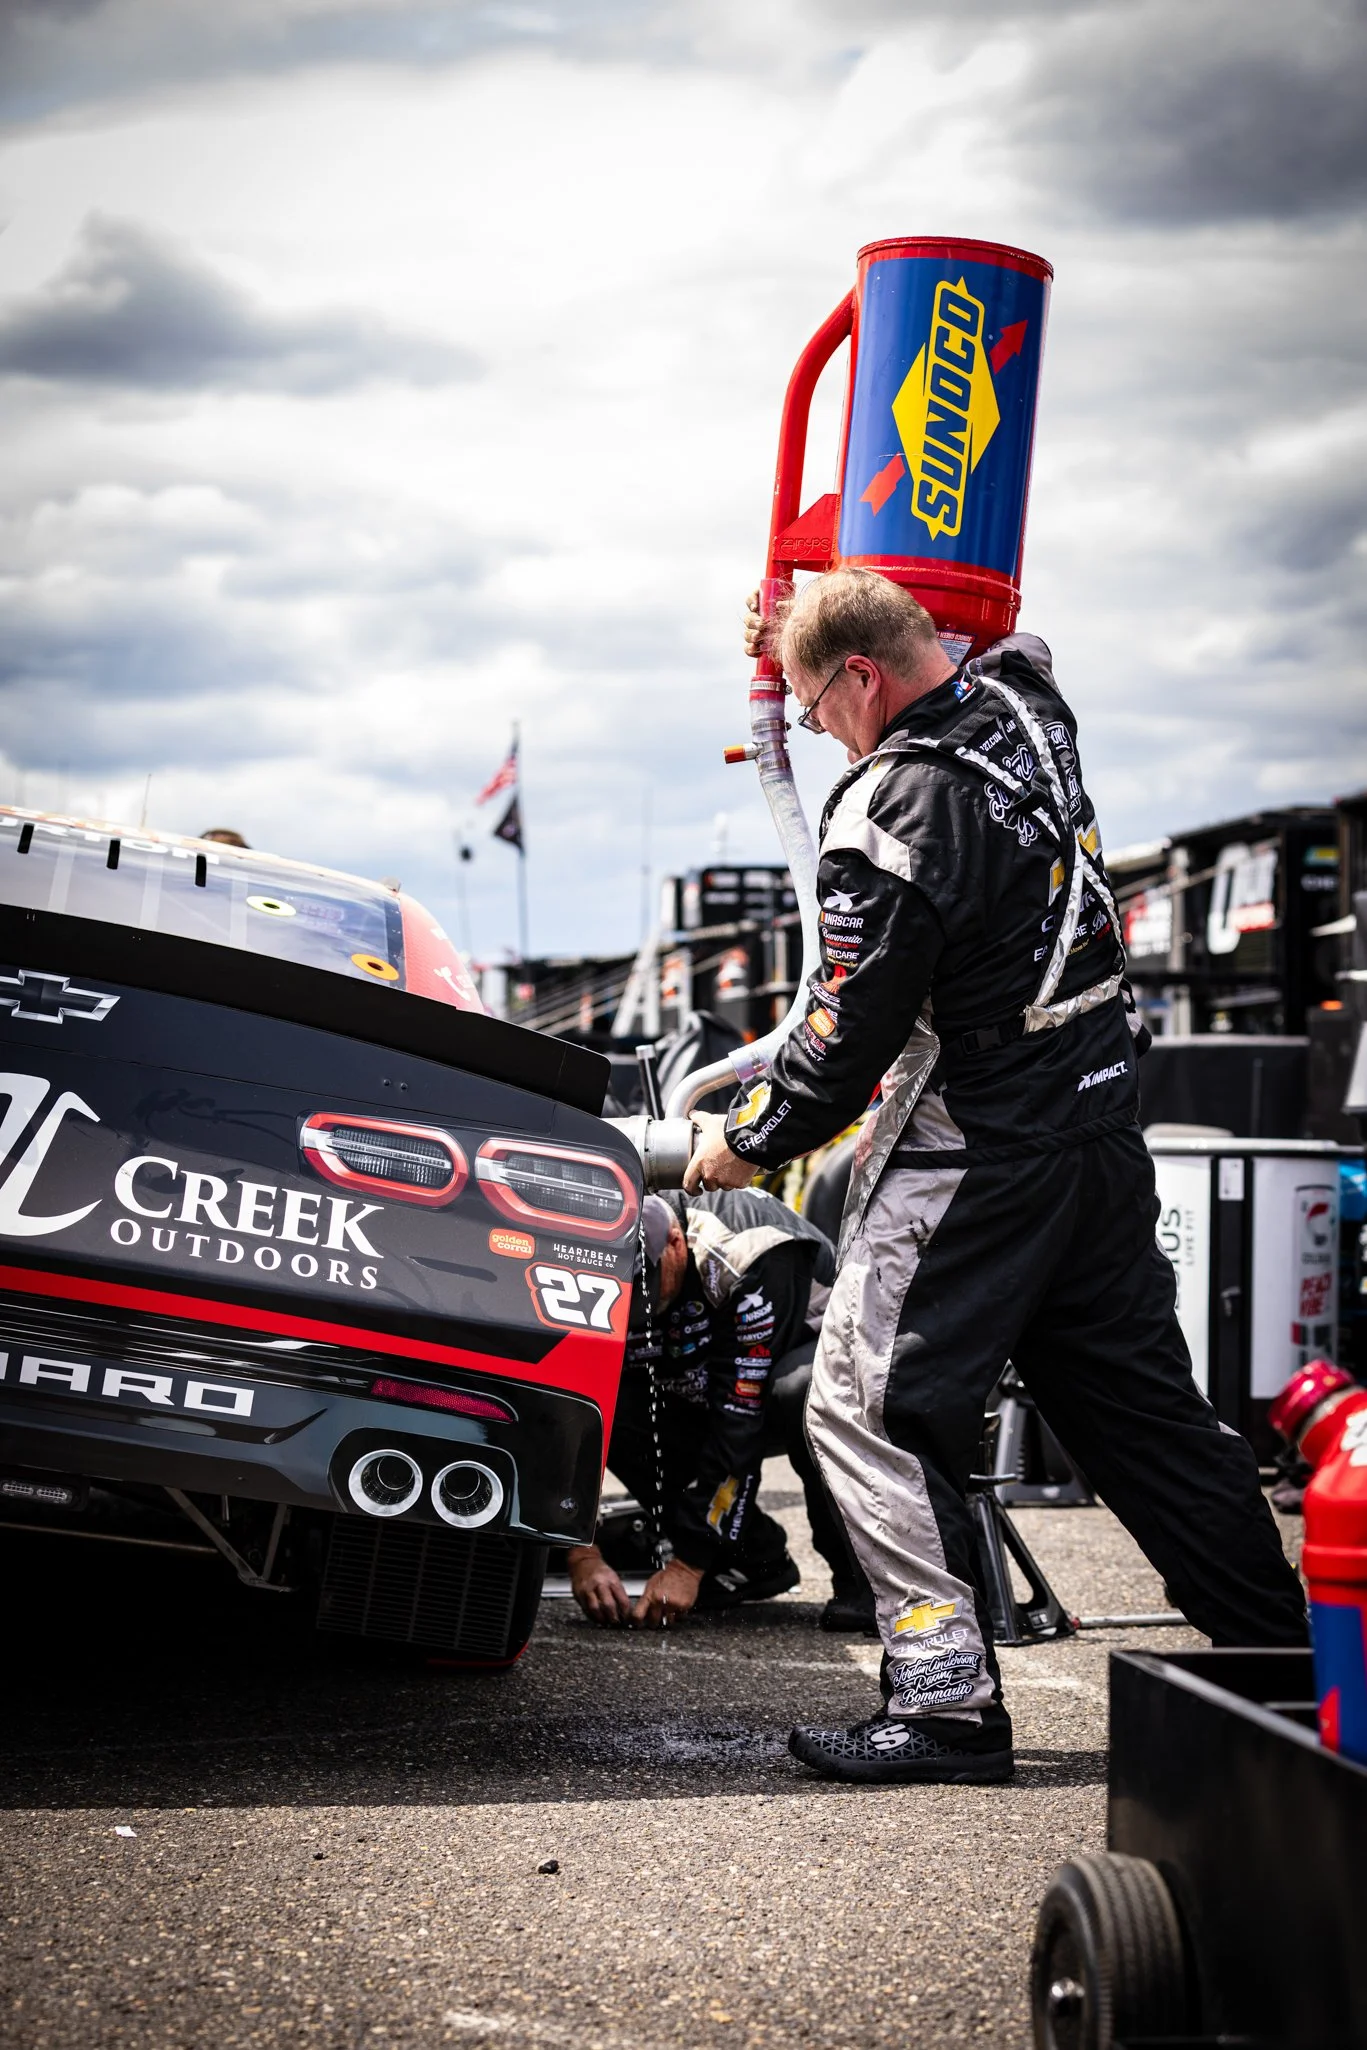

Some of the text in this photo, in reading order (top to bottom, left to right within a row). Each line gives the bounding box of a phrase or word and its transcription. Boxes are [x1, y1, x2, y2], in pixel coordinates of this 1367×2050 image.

[917, 287, 980, 529] SUNOCO
[827, 913, 864, 928] NASCAR
[737, 1100, 792, 1152] CHEVROLET
[115, 1155, 385, 1259] CREEK
[492, 1233, 529, 1246] golden
[497, 1241, 532, 1254] corral
[110, 1218, 379, 1290] OUTDOORS
[553, 1243, 618, 1263] HEARTBEAT
[558, 1253, 575, 1261] HOT
[576, 1256, 602, 1267] SAUCE
[535, 1266, 620, 1330] 27
[893, 1629, 969, 1655] CHEVROLET
[893, 1659, 929, 1687] Jordan
[914, 1670, 953, 1692] Racing
[901, 1682, 973, 1705] Bommarito
[922, 1695, 963, 1706] AUTOSPORT
